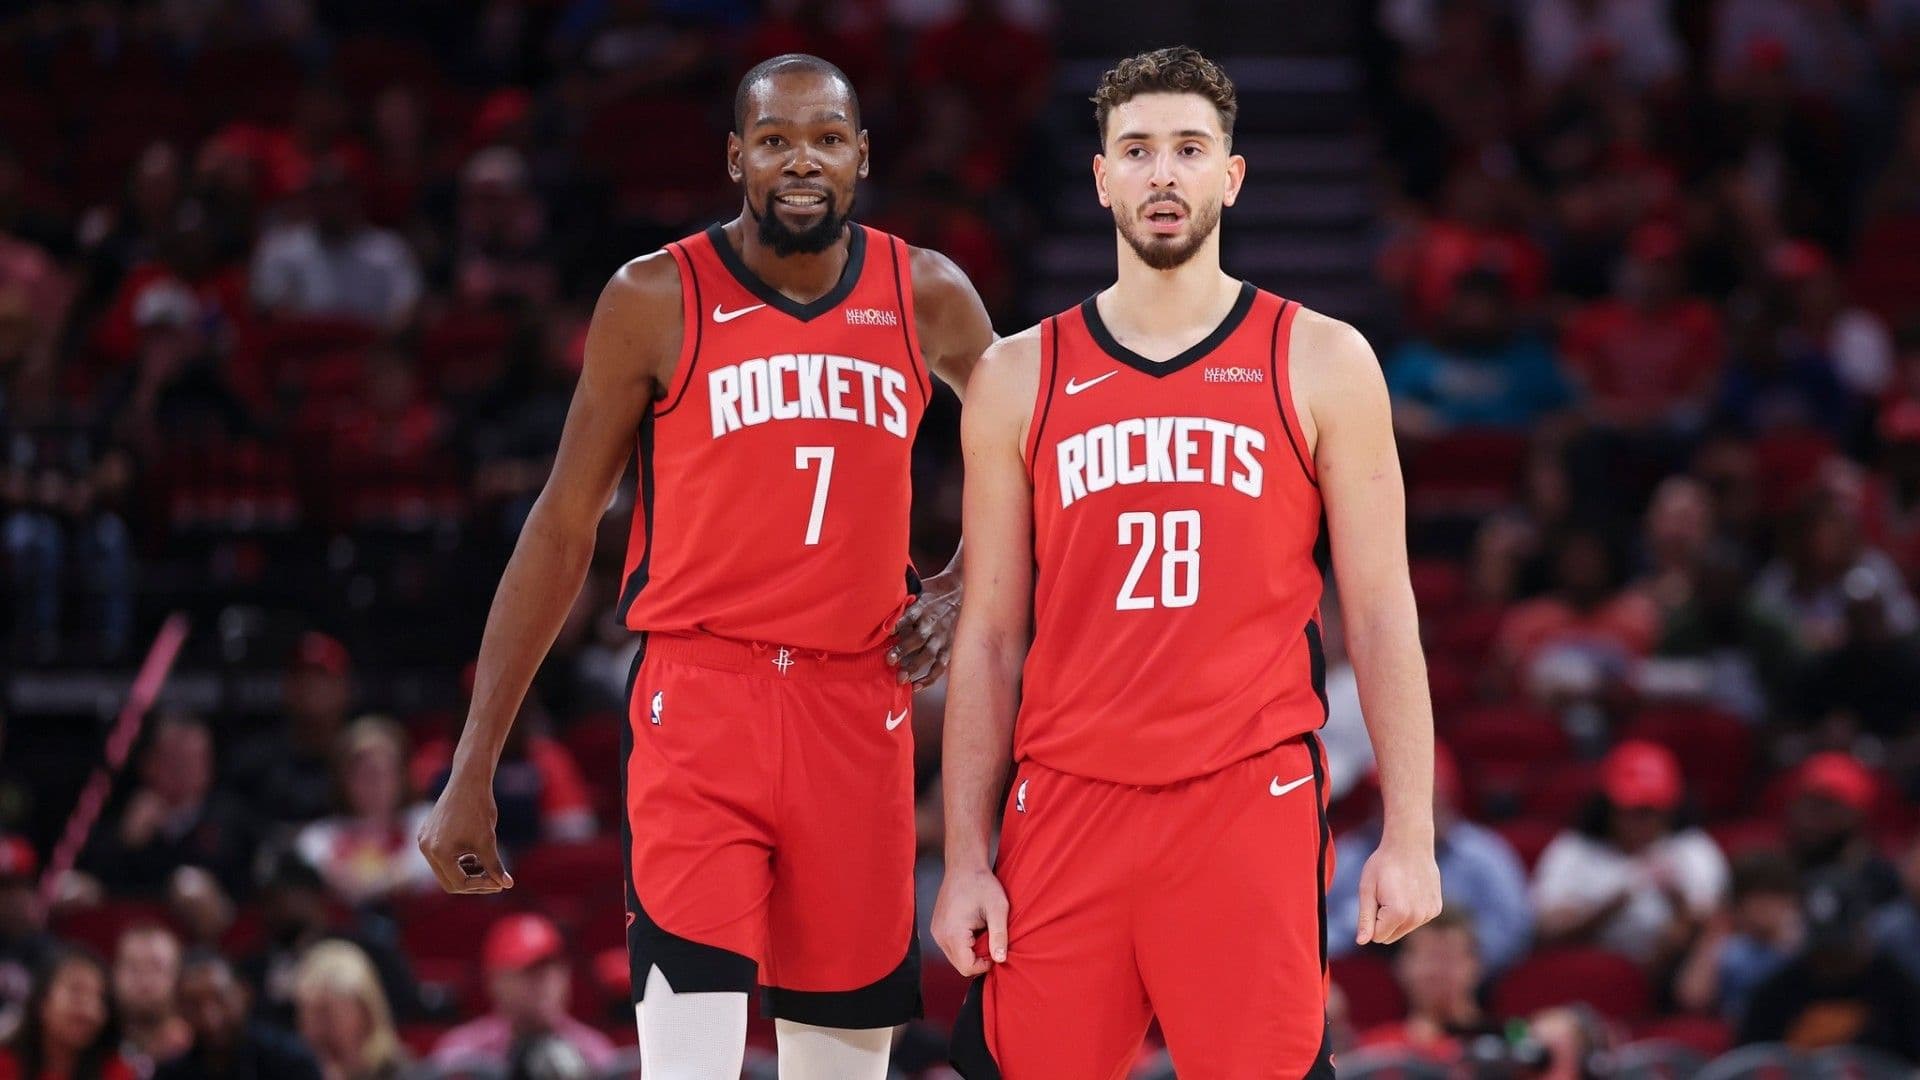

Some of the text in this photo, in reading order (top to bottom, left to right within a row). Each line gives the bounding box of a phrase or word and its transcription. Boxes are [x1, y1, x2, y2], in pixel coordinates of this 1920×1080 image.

[846, 308, 894, 318] MEMORIAL
[847, 316, 897, 325] HERMANN
[1204, 374, 1263, 382] HERMANN
[1205, 367, 1262, 376] MEMORIAL
[708, 354, 907, 439] ROCKETS
[1057, 416, 1266, 510] ROCKETS
[794, 446, 835, 545] 7
[1116, 509, 1201, 611] 28
